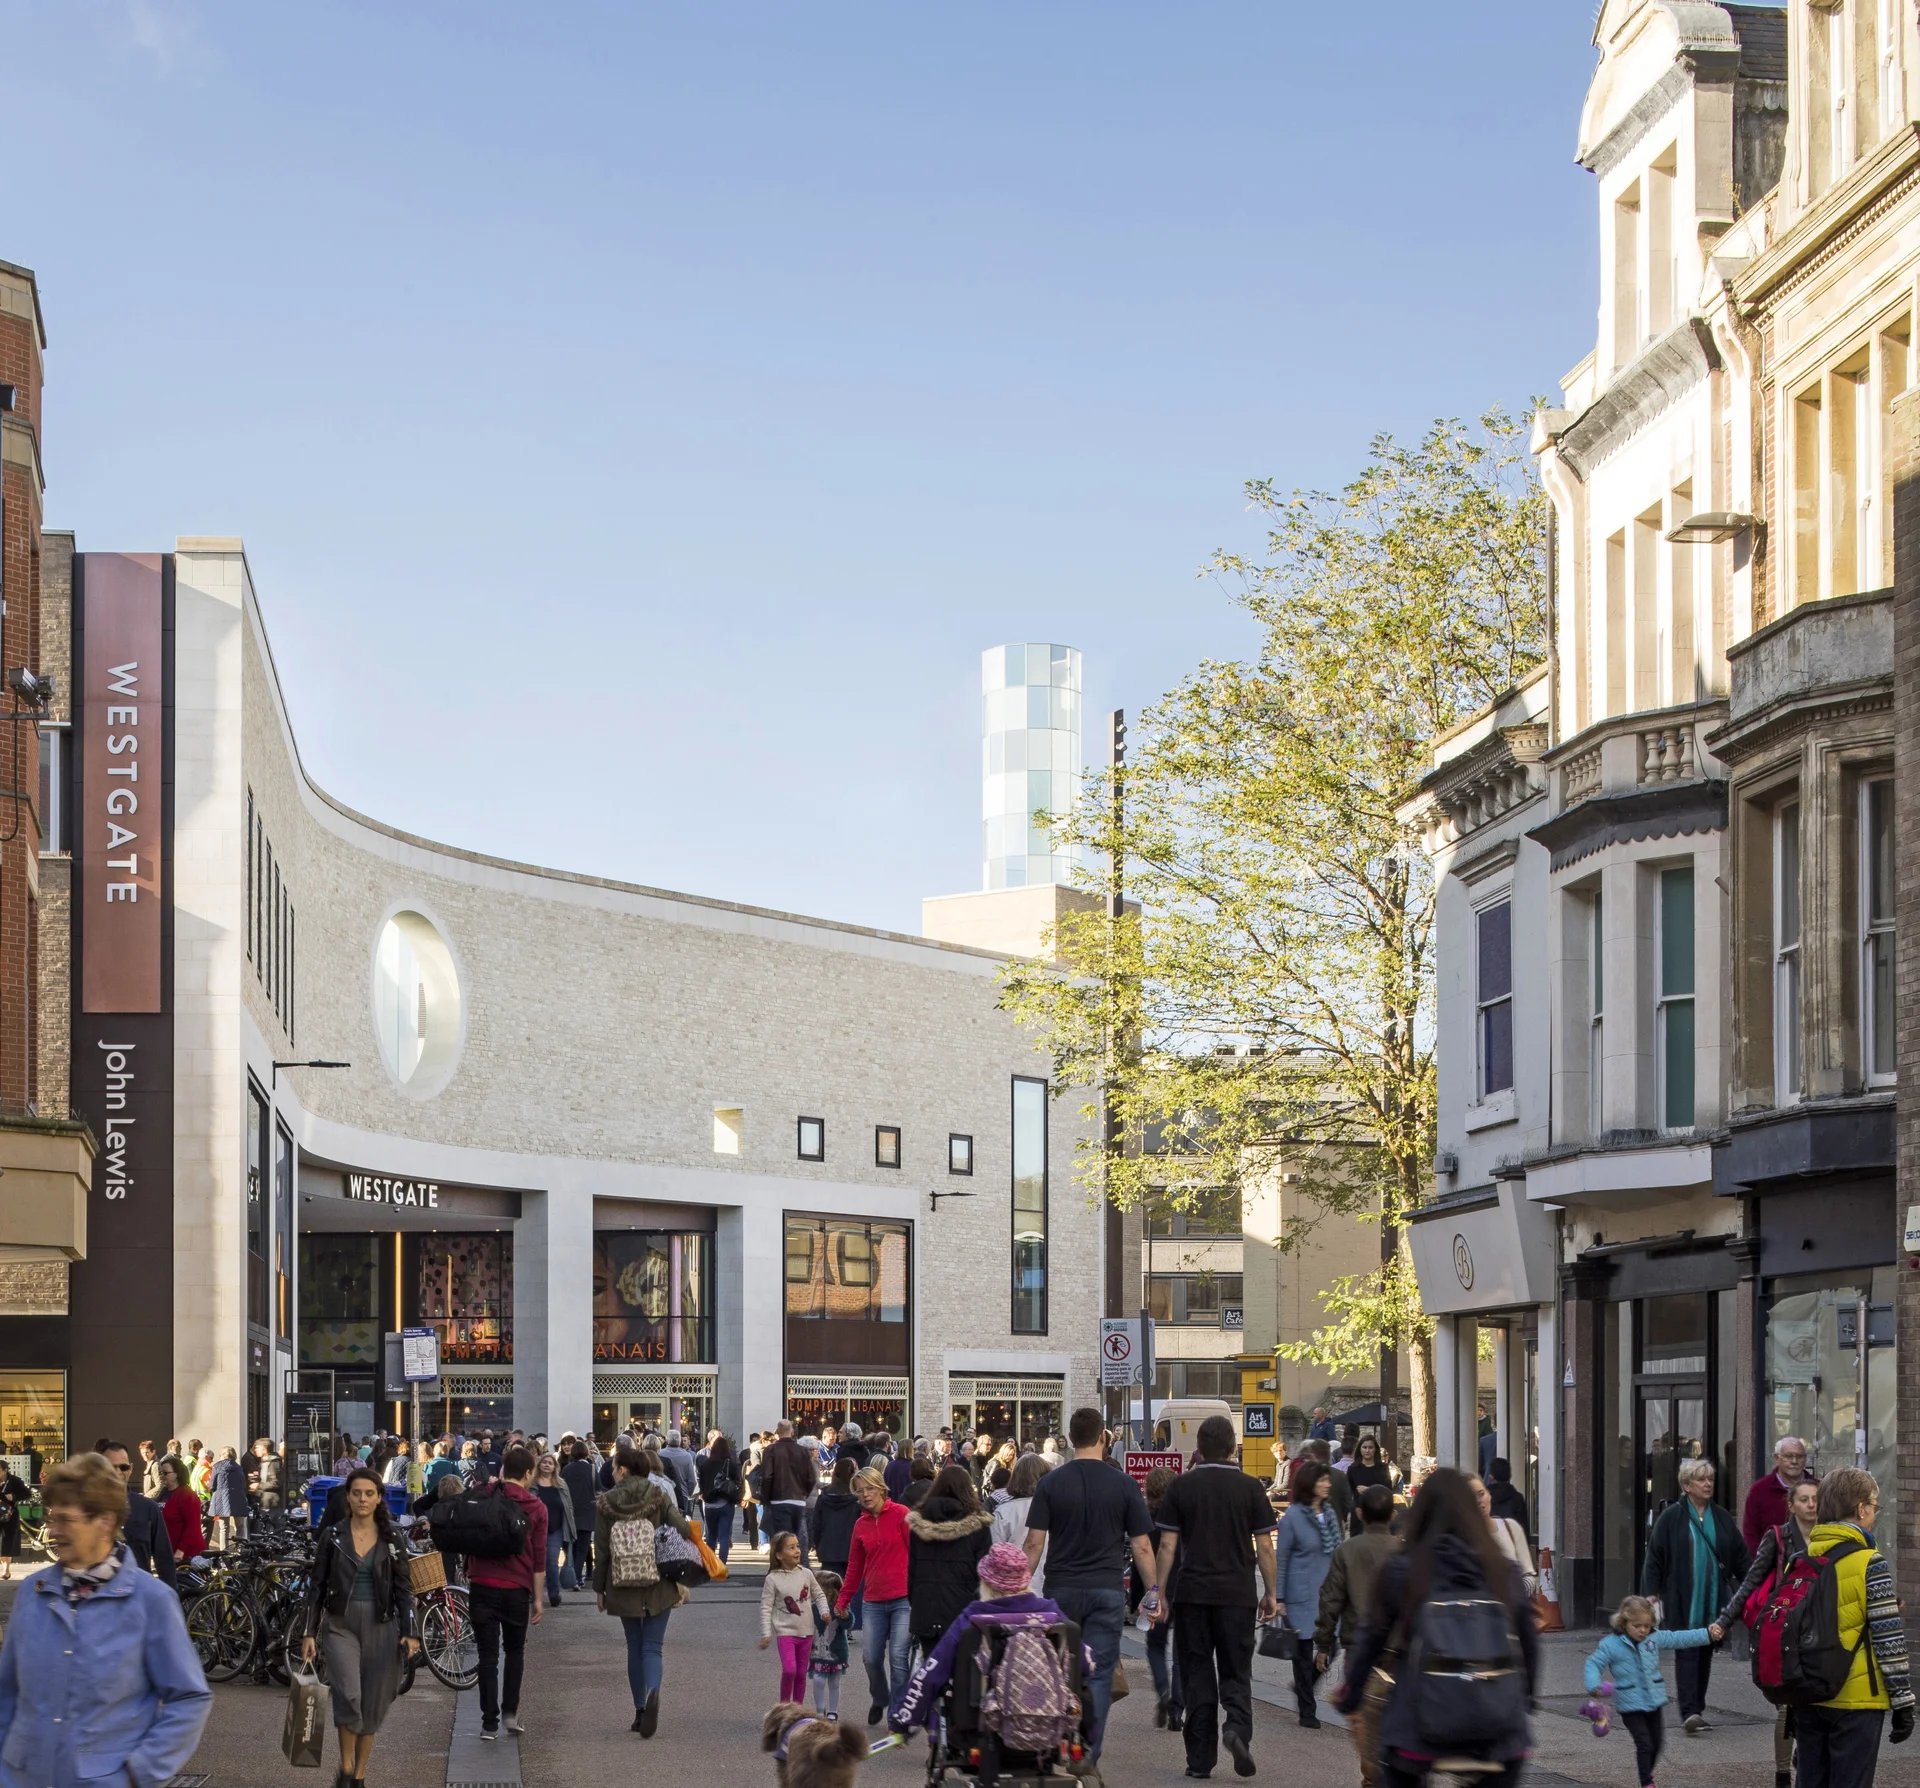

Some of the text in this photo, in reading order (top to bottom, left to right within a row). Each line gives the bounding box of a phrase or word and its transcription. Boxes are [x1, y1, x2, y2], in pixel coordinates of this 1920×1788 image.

[106, 661, 138, 903] WESTGATE
[97, 1039, 136, 1200] John Lewis
[350, 1174, 438, 1208] WESTGATE
[789, 1399, 900, 1412] COMPTOIR LIBANAIS
[1249, 1412, 1264, 1421] Art
[1249, 1420, 1267, 1430] Café
[1128, 1457, 1180, 1468] DANGER
